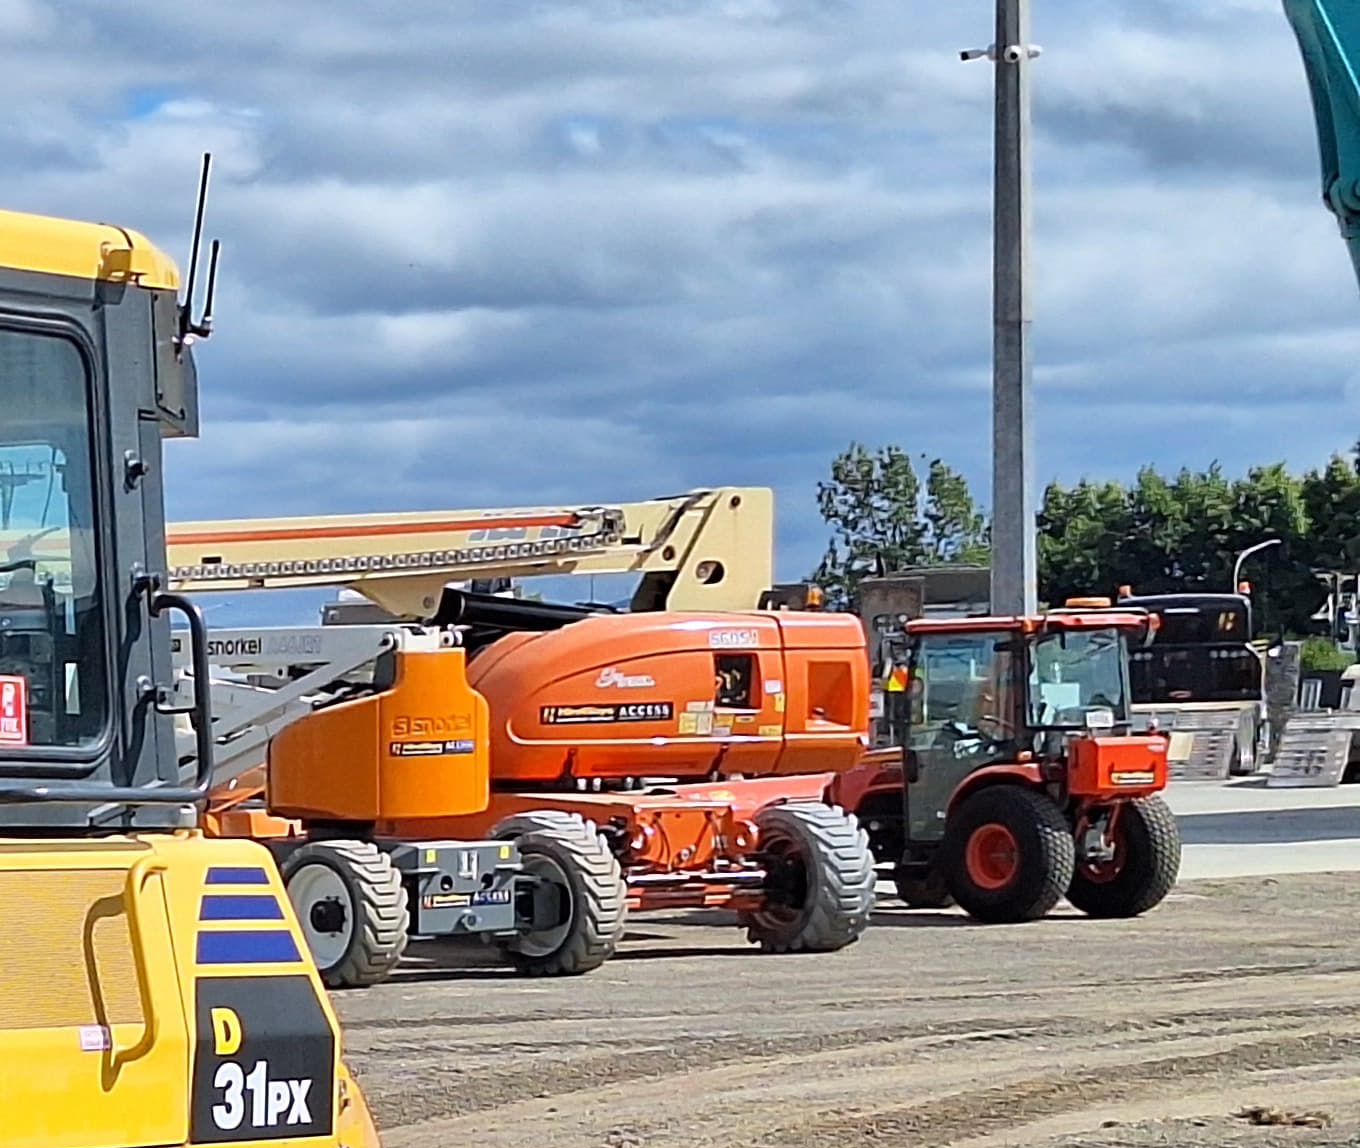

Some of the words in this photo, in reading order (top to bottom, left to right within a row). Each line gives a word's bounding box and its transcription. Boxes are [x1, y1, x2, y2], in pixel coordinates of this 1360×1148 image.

[208, 637, 262, 656] snorkel
[618, 704, 670, 717] ACCESS
[211, 1008, 242, 1055] D
[212, 1061, 312, 1130] 31PX
